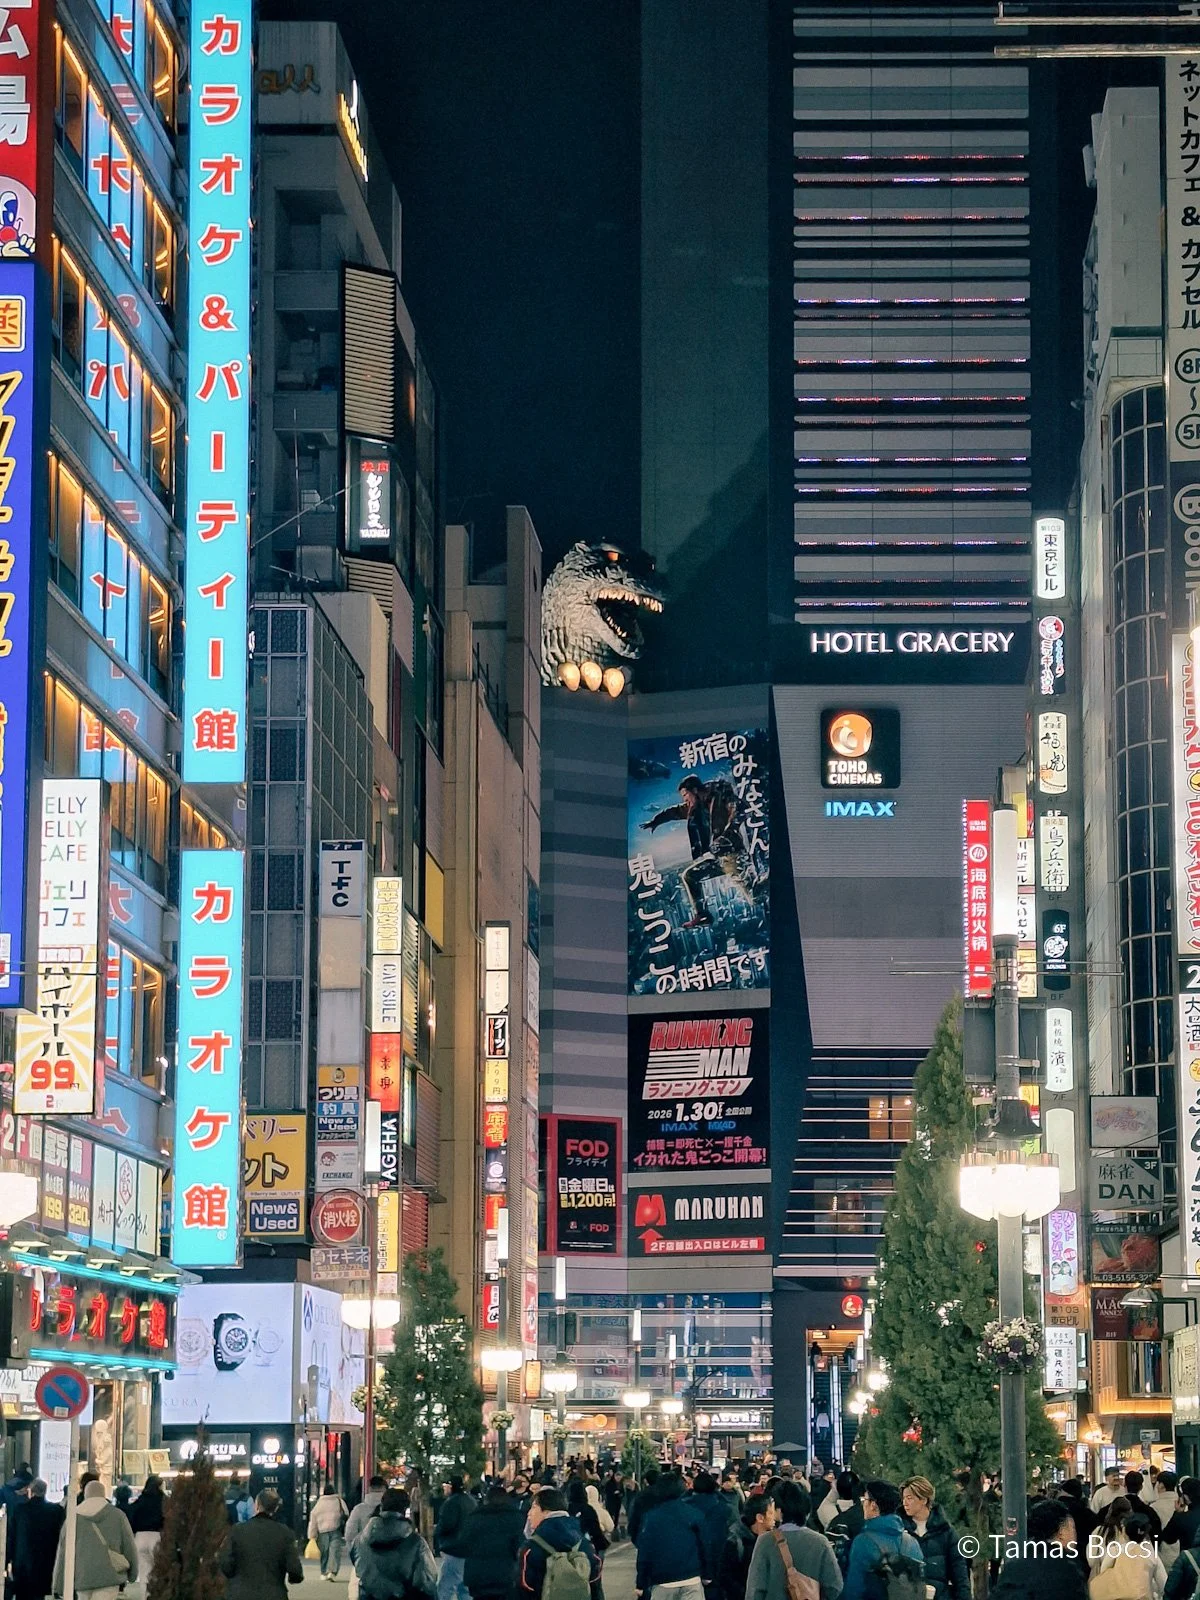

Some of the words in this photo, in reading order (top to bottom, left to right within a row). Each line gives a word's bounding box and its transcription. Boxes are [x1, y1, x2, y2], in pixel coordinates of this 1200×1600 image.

[1044, 534, 1058, 591] 東京ビル
[811, 632, 893, 653] HOTEL
[897, 632, 1015, 653] GRACERY
[828, 761, 868, 773] TOHO
[828, 774, 883, 785] CINEMAS
[825, 802, 895, 817] IMAX
[331, 860, 352, 908] TFC
[1054, 924, 1067, 933] 6F
[1186, 965, 1200, 989] 2
[495, 1018, 506, 1049] ダーツ
[649, 1017, 754, 1050] RUNNING
[182, 881, 236, 1230] カラオケ館
[700, 1047, 751, 1077] MAN
[319, 1087, 358, 1101] つり具
[648, 1080, 743, 1098] ランニング・マン
[647, 1110, 673, 1120] 2026
[675, 1101, 717, 1122] 1.30
[486, 1112, 506, 1143] 麻雀
[660, 1122, 699, 1133] IMAX
[381, 1117, 398, 1181] AGEHA
[566, 1139, 609, 1157] FOD
[1098, 1164, 1136, 1180] 麻雀
[1144, 1161, 1158, 1170] 3F
[1098, 1183, 1155, 1200] DAN
[674, 1195, 764, 1221] MARUHAN
[255, 1217, 298, 1230] Used
[323, 1210, 358, 1229] 消火栓
[589, 1223, 609, 1232] FOD
[327, 1250, 368, 1265] セキネ
[203, 1443, 247, 1456] KURA
[252, 1455, 290, 1465] OKURA
